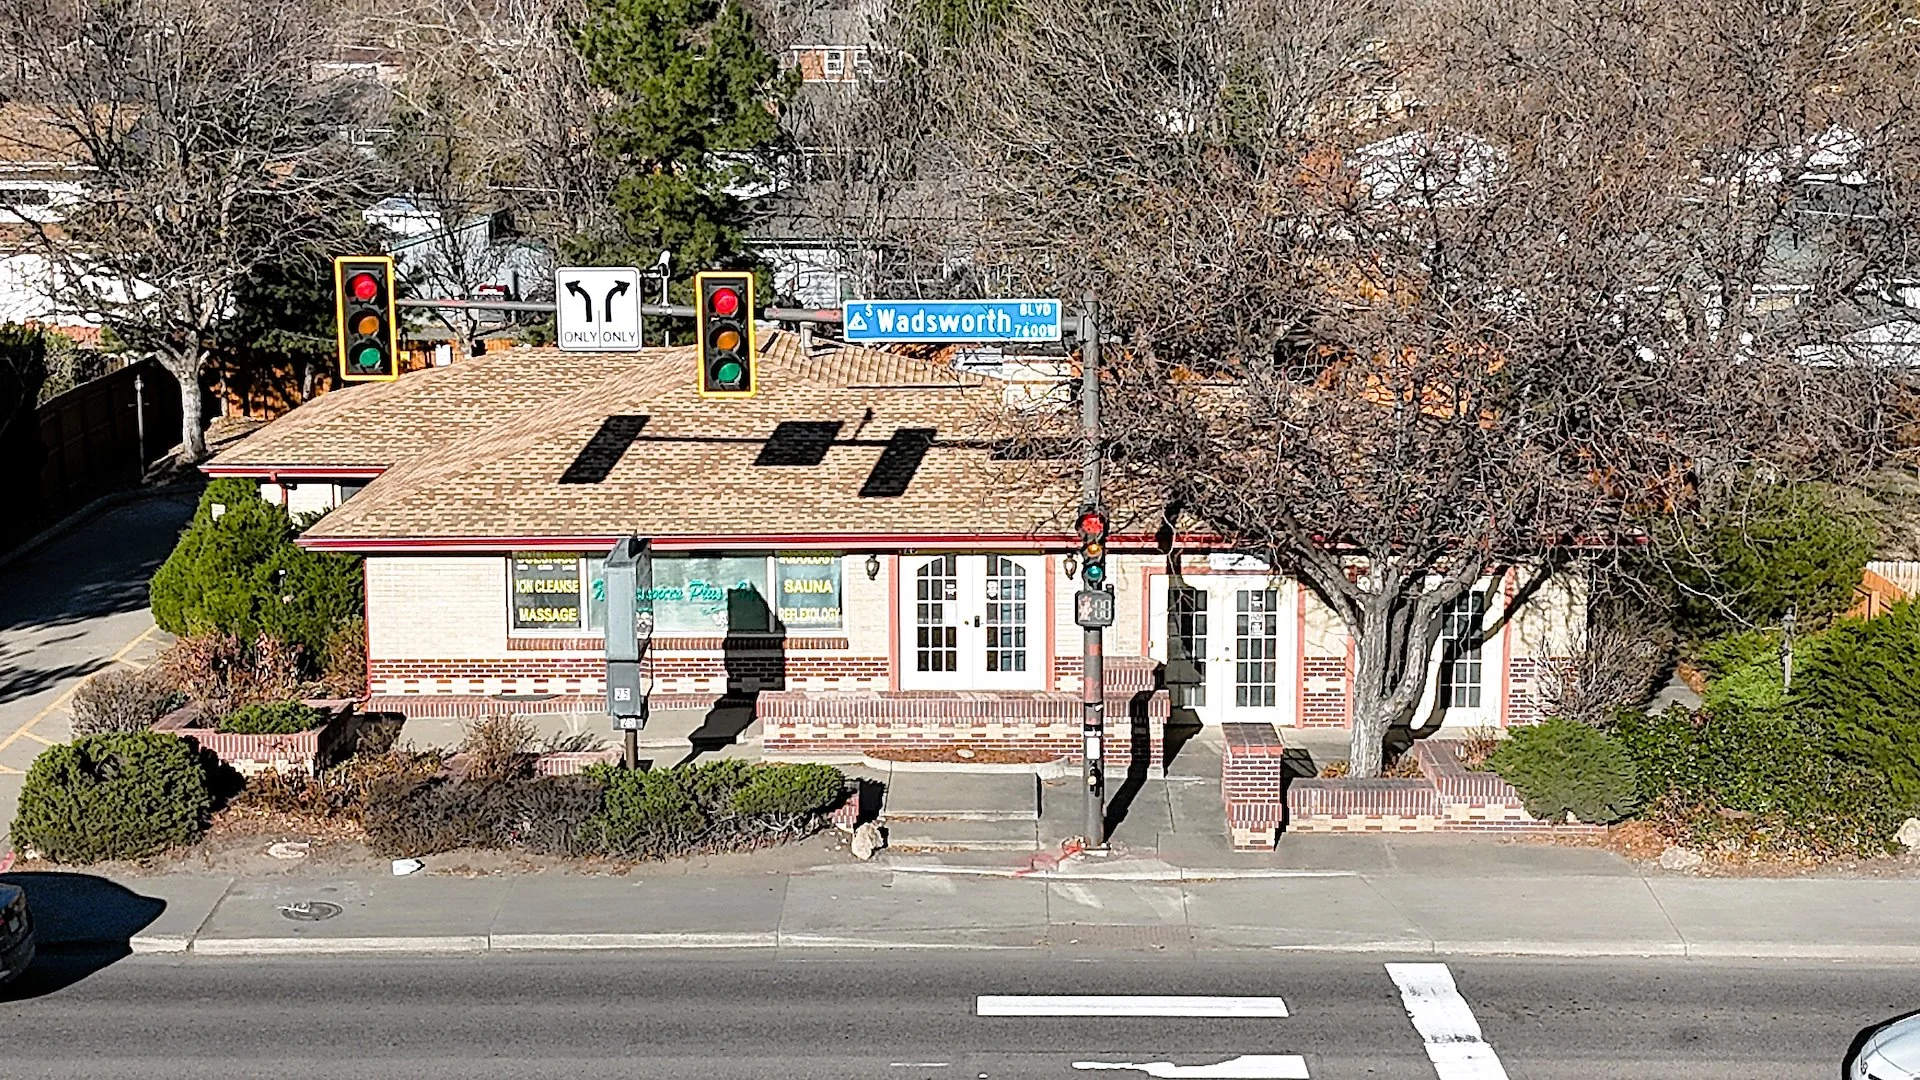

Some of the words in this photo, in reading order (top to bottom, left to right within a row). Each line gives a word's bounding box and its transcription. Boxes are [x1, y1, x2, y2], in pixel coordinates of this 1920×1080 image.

[866, 303, 873, 318] S
[877, 308, 1012, 334] Wadsworth
[1019, 303, 1052, 317] BLVD
[564, 331, 597, 342] ONLY
[602, 331, 636, 342] ONLY
[1014, 323, 1057, 338] 7600W
[516, 579, 534, 594] ION
[534, 579, 580, 594] CLEANSE
[783, 579, 834, 594] SAUNA
[518, 607, 578, 622] MASSAGE
[777, 607, 841, 622] REFLEXOLOGY
